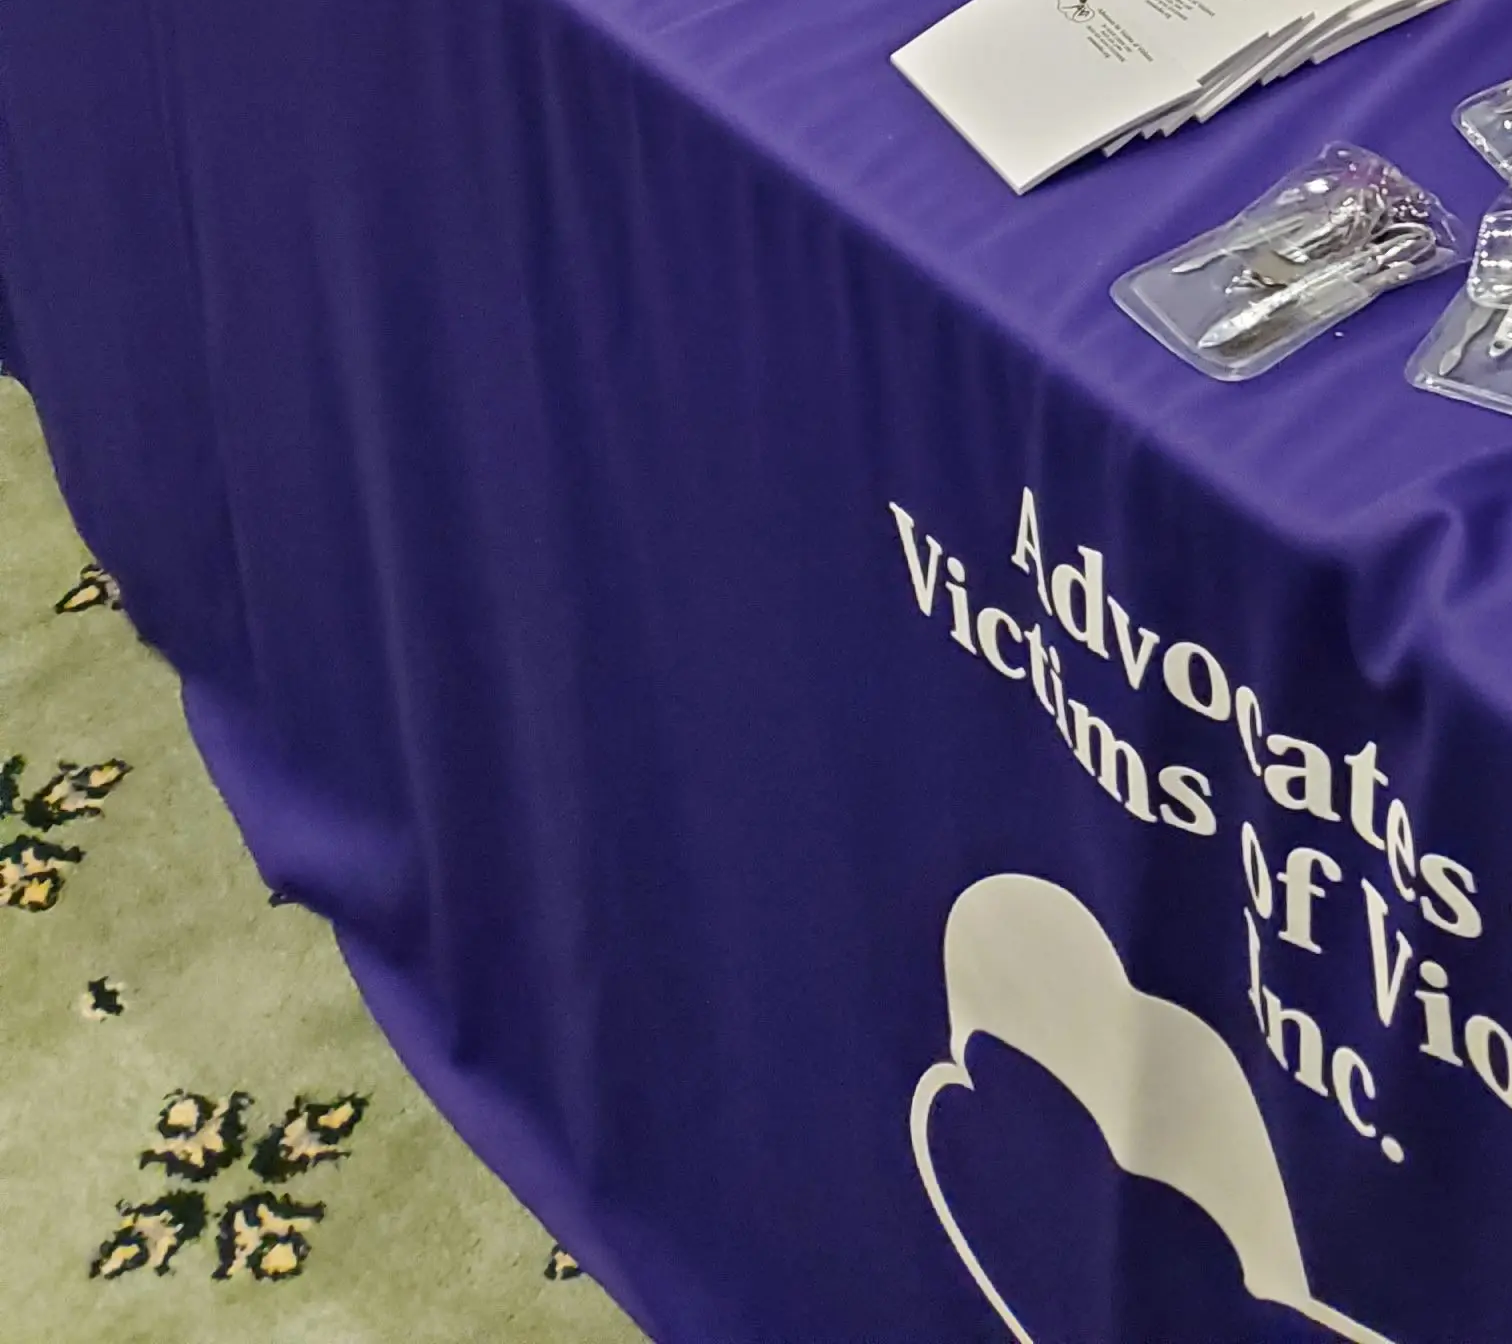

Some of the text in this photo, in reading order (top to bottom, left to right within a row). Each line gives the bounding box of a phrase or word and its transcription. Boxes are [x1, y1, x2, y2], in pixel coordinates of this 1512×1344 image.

[889, 501, 1217, 836] Victims
[1241, 821, 1342, 954] of
[1011, 486, 1483, 939] Advocates
[1243, 906, 1405, 1163] Inc.
